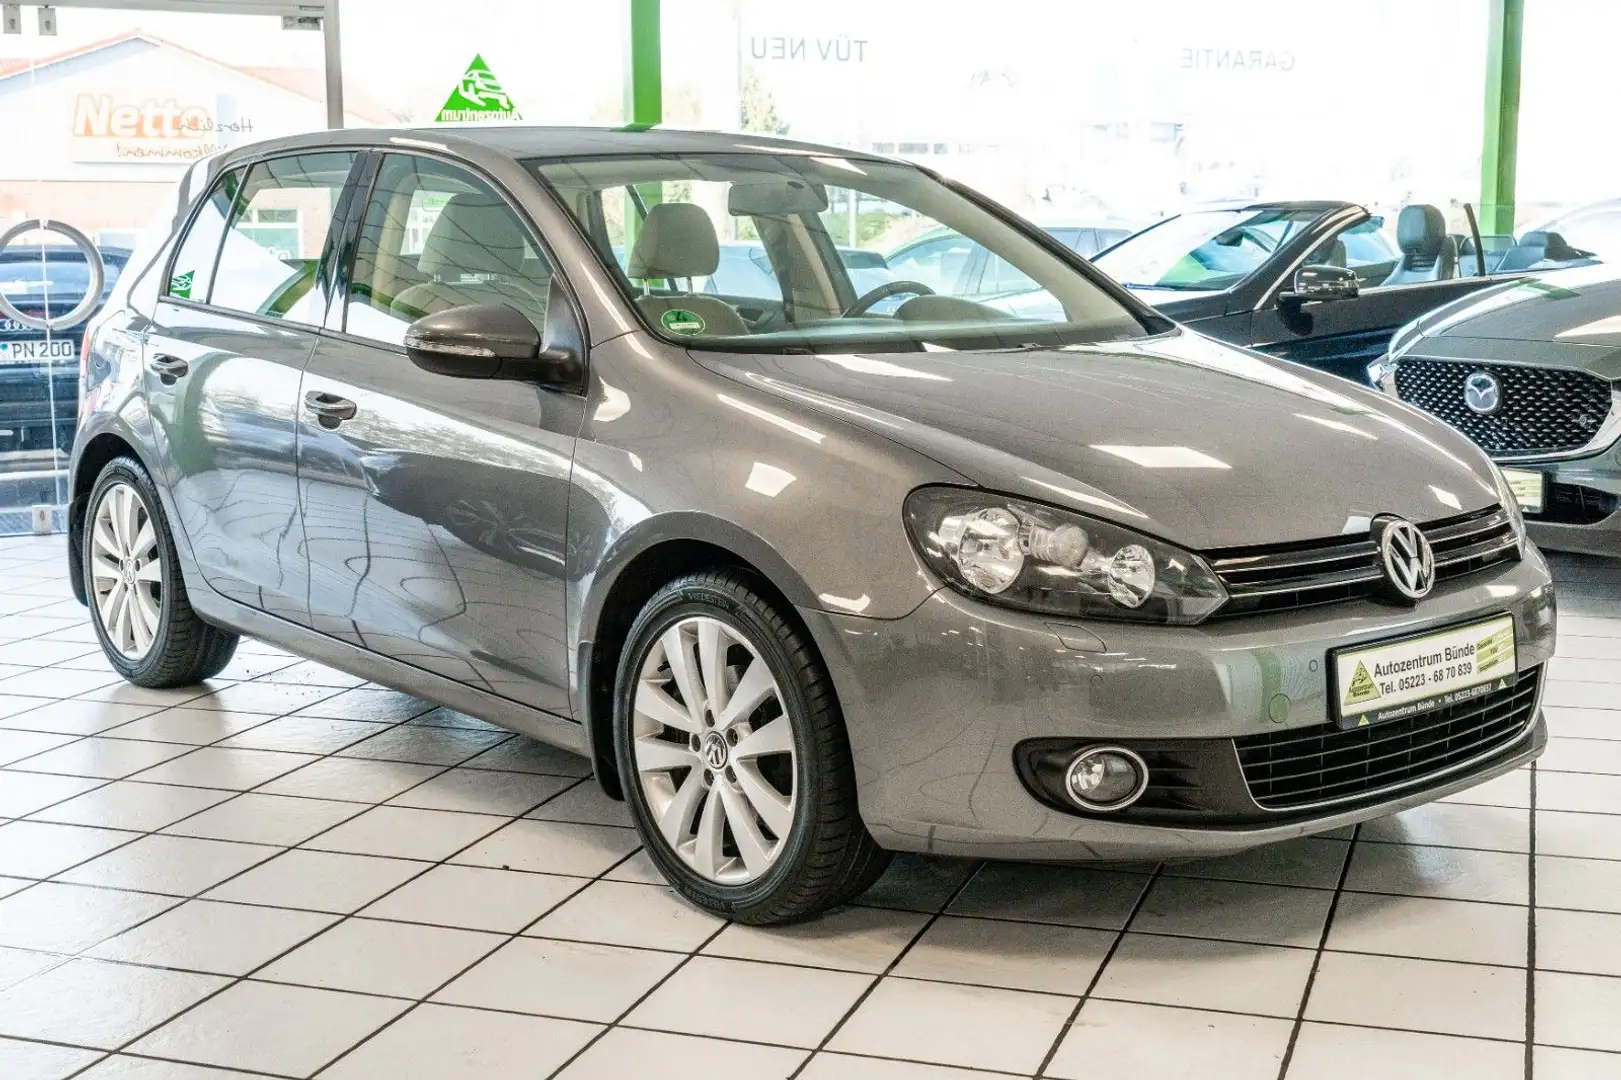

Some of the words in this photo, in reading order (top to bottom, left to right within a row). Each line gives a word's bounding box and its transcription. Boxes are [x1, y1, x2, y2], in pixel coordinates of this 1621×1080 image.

[73, 93, 211, 138] Netto
[12, 342, 35, 359] PN
[39, 341, 72, 358] 200
[1374, 652, 1442, 677] Autozentrum
[1444, 643, 1475, 662] Bünde
[1380, 681, 1397, 695] Tel.
[1399, 673, 1426, 691] 05223
[1433, 669, 1444, 682] 68
[1446, 666, 1456, 679] 70
[1457, 662, 1472, 676] 839
